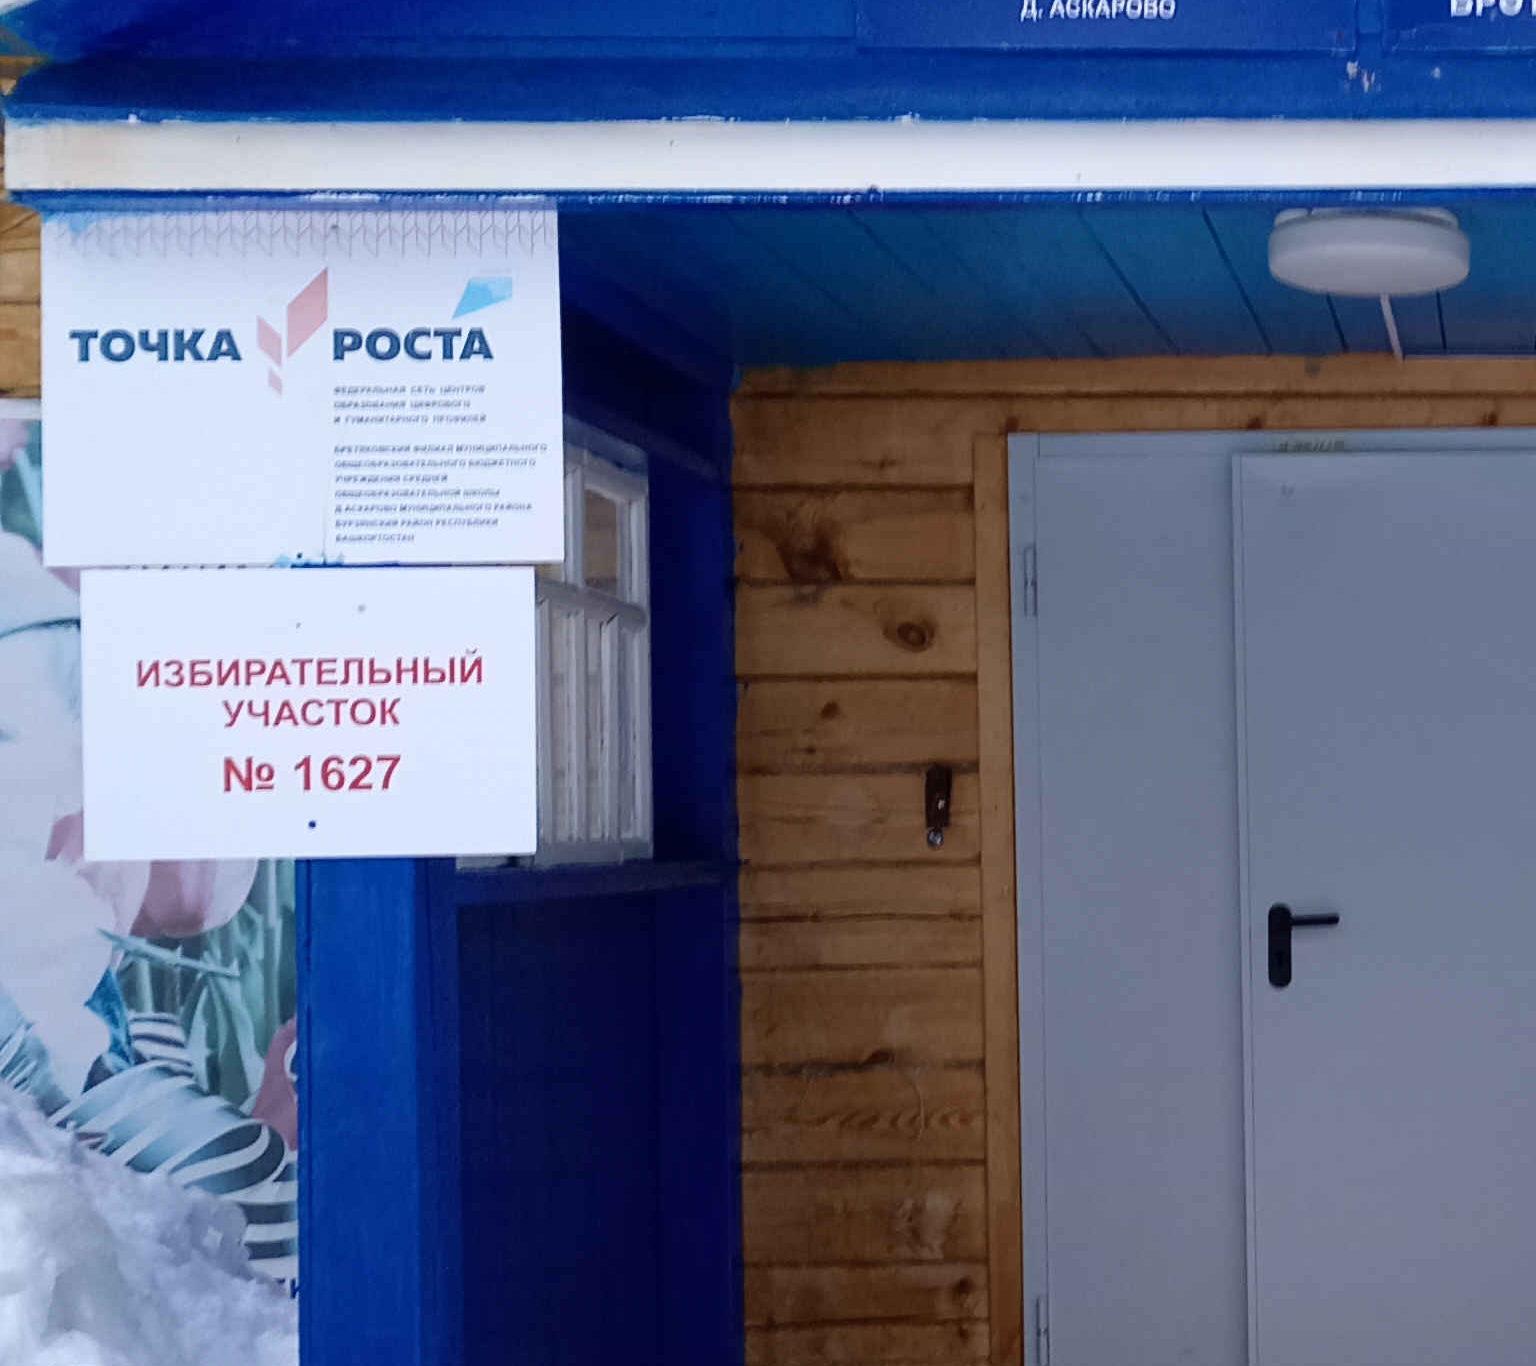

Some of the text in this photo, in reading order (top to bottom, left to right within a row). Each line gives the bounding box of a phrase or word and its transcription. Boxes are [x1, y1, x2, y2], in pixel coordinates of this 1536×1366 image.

[69, 328, 494, 362] ТОЧКА РОСТА
[137, 649, 482, 687] ИЗБИРАТЕЛЬНЫЙ
[223, 698, 400, 727] УЧАСТОК
[224, 755, 401, 792] № 1627
